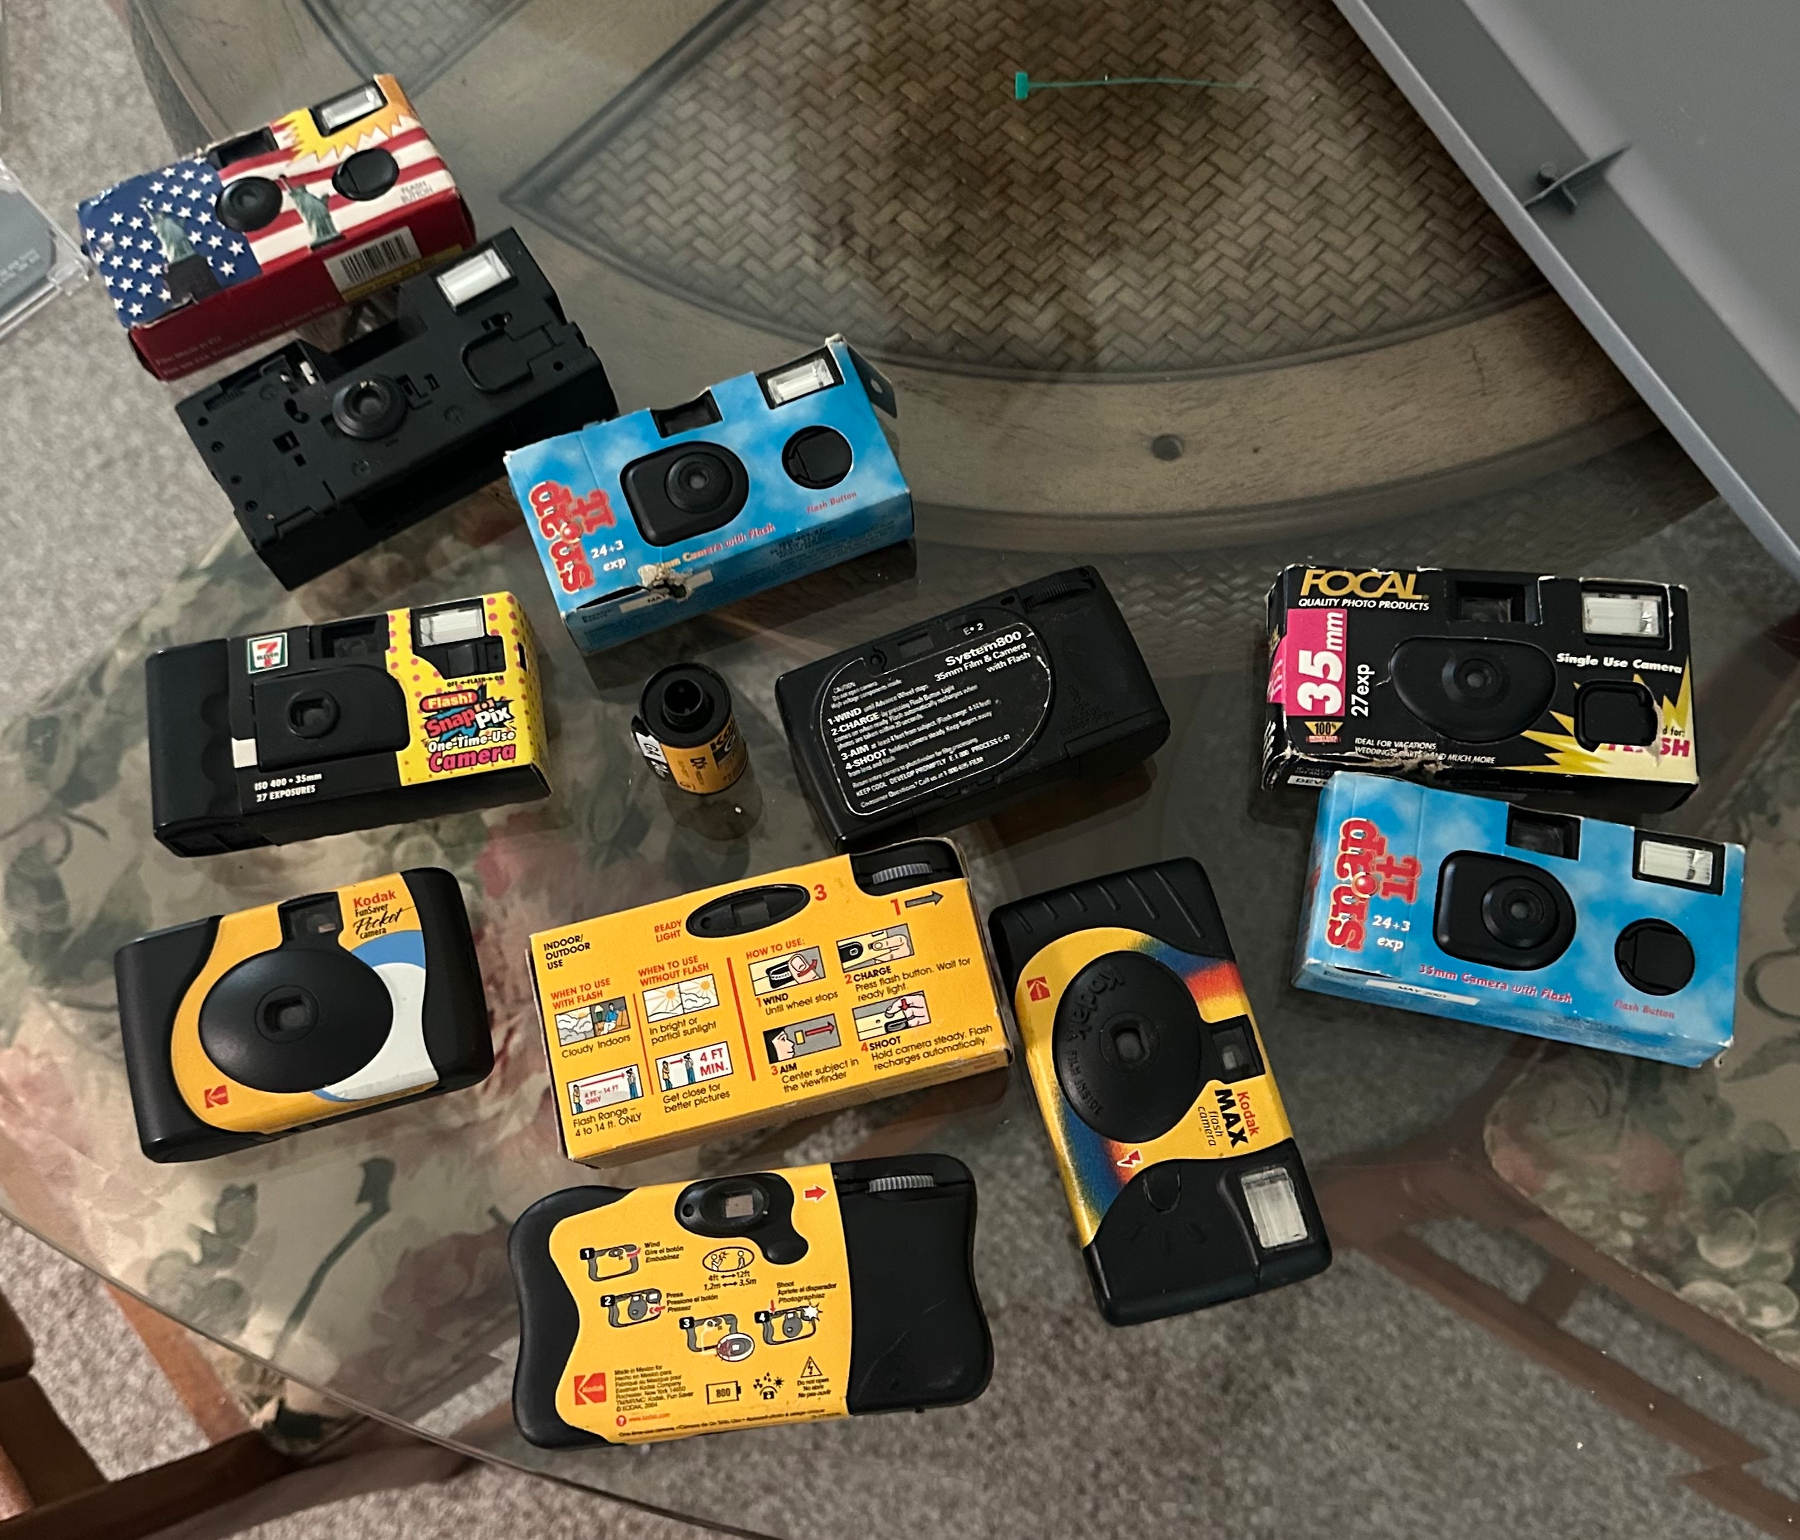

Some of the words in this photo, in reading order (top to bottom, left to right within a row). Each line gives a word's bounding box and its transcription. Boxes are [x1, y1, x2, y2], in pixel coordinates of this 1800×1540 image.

[805, 501, 828, 514] Flash
[829, 492, 857, 505] Button
[726, 532, 747, 547] with
[750, 522, 776, 539] Flash
[591, 540, 624, 559] 24+3
[682, 543, 724, 562] Camera
[603, 558, 626, 571] exp
[1300, 569, 1424, 600] FOCAL
[1298, 598, 1340, 607] QUALITY
[1341, 598, 1377, 608] PHOTO
[1378, 600, 1429, 611] PRODUCTS
[257, 641, 278, 668] 7
[945, 631, 1022, 666] System800
[934, 667, 963, 681] 35mm
[963, 659, 983, 670] Film
[992, 643, 1027, 659] Camera
[986, 661, 1007, 672] with
[1007, 652, 1031, 665] Flash
[1297, 612, 1343, 714] 35mm
[1556, 653, 1599, 667] Single
[1603, 657, 1628, 667] Use
[1632, 659, 1682, 674] Camera
[466, 676, 486, 685] FLASH
[1351, 664, 1375, 717] 27exp
[428, 692, 473, 709] Flash!
[424, 709, 477, 738] Snap
[474, 705, 513, 729] Pix
[827, 708, 862, 725] 1-WIND
[831, 712, 880, 736] 2-CHARGE
[426, 728, 516, 753] One-Time-Use
[1670, 726, 1685, 737] for:
[1355, 738, 1374, 746] IDEAL
[427, 743, 517, 773] Camera
[841, 744, 870, 760] 3-AIM
[845, 748, 886, 769] 4-SHOOT
[1447, 754, 1470, 762] MUCH
[1472, 756, 1496, 764] MORE
[254, 781, 268, 791] ISO
[270, 778, 287, 787] 400
[295, 773, 322, 783] 35mm
[256, 793, 268, 802] 27
[269, 784, 316, 800] EXPOSURES
[353, 890, 396, 908] Kodak
[813, 884, 828, 901] 3
[355, 903, 388, 917] FunSaver
[890, 898, 901, 916] 1
[353, 907, 403, 935] Pocket
[654, 919, 682, 933] READY
[1372, 915, 1411, 931] 24+3
[359, 928, 387, 939] camera
[543, 934, 583, 951] INDOOR/
[656, 929, 681, 943] LIGHT
[545, 942, 591, 960] OUTDOOR
[746, 947, 768, 960] HOW
[770, 943, 783, 953] TO
[785, 938, 805, 949] USE:
[1377, 937, 1404, 952] exp
[547, 959, 563, 970] USE
[638, 964, 665, 977] WHEN
[667, 960, 680, 969] TO
[682, 955, 698, 966] USE
[639, 969, 680, 987] WITHOUT
[682, 962, 709, 976] FLASH
[844, 974, 853, 984] 2
[853, 965, 892, 982] CHARGE
[855, 981, 878, 992] Press
[879, 974, 901, 986] flash
[902, 967, 933, 980] button.
[936, 960, 956, 971] Wait
[958, 958, 970, 966] for
[1419, 965, 1458, 981] 35mm
[1463, 974, 1509, 991] Camera
[1513, 985, 1538, 997] with
[550, 988, 576, 1000] WHEN
[579, 983, 592, 992] TO
[594, 978, 610, 988] USE
[858, 989, 884, 1002] ready
[886, 982, 906, 995] light.
[1541, 987, 1573, 1004] Flash
[552, 997, 575, 1010] WITH
[576, 990, 603, 1003] FLASH
[756, 997, 762, 1007] 1
[763, 993, 789, 1006] WIND
[765, 1004, 784, 1016] Until
[786, 996, 813, 1010] wheel
[815, 991, 838, 1003] stops
[1613, 998, 1639, 1012] Flash
[1642, 1005, 1675, 1019] Button
[649, 1027, 658, 1035] In
[659, 1019, 689, 1033] bright
[689, 1017, 697, 1025] or
[651, 1029, 681, 1045] partial
[682, 1020, 717, 1037] sunlight
[561, 1044, 594, 1058] Cloudy
[597, 1034, 631, 1049] Indoors
[861, 1042, 868, 1052] 4
[869, 1036, 901, 1051] SHOOT
[871, 1048, 893, 1061] Hold
[895, 1040, 932, 1055] camera
[933, 1032, 965, 1045] steady.
[968, 1024, 993, 1036] Flash
[700, 1052, 707, 1062] 4
[711, 1048, 723, 1059] FT
[874, 1053, 921, 1071] recharges
[922, 1037, 988, 1059] automatically.
[700, 1061, 728, 1076] MIN.
[771, 1065, 778, 1076] 3
[780, 1062, 797, 1074] AIM
[781, 1070, 813, 1084] Center
[815, 1060, 848, 1076] subject
[850, 1058, 859, 1066] in
[783, 1084, 799, 1093] the
[800, 1071, 847, 1089] viewfinder
[662, 1092, 680, 1104] Get
[682, 1087, 706, 1099] close
[708, 1083, 721, 1092] for
[664, 1101, 691, 1113] better
[694, 1091, 730, 1107] pictures
[573, 1115, 596, 1128] Flash
[598, 1107, 628, 1121] Range
[1214, 1089, 1249, 1148] MAX
[1237, 1091, 1260, 1137] Kodak
[1198, 1106, 1216, 1146] camera
[1208, 1111, 1224, 1137] flash
[585, 1250, 590, 1258] 1
[736, 1270, 750, 1278] 12ft
[704, 1283, 721, 1291] 1,2m
[739, 1278, 757, 1286] 3,5m
[605, 1296, 611, 1305] 2
[682, 1318, 691, 1328] 3
[759, 1313, 765, 1321] 4
[583, 1385, 604, 1393] Kodak
